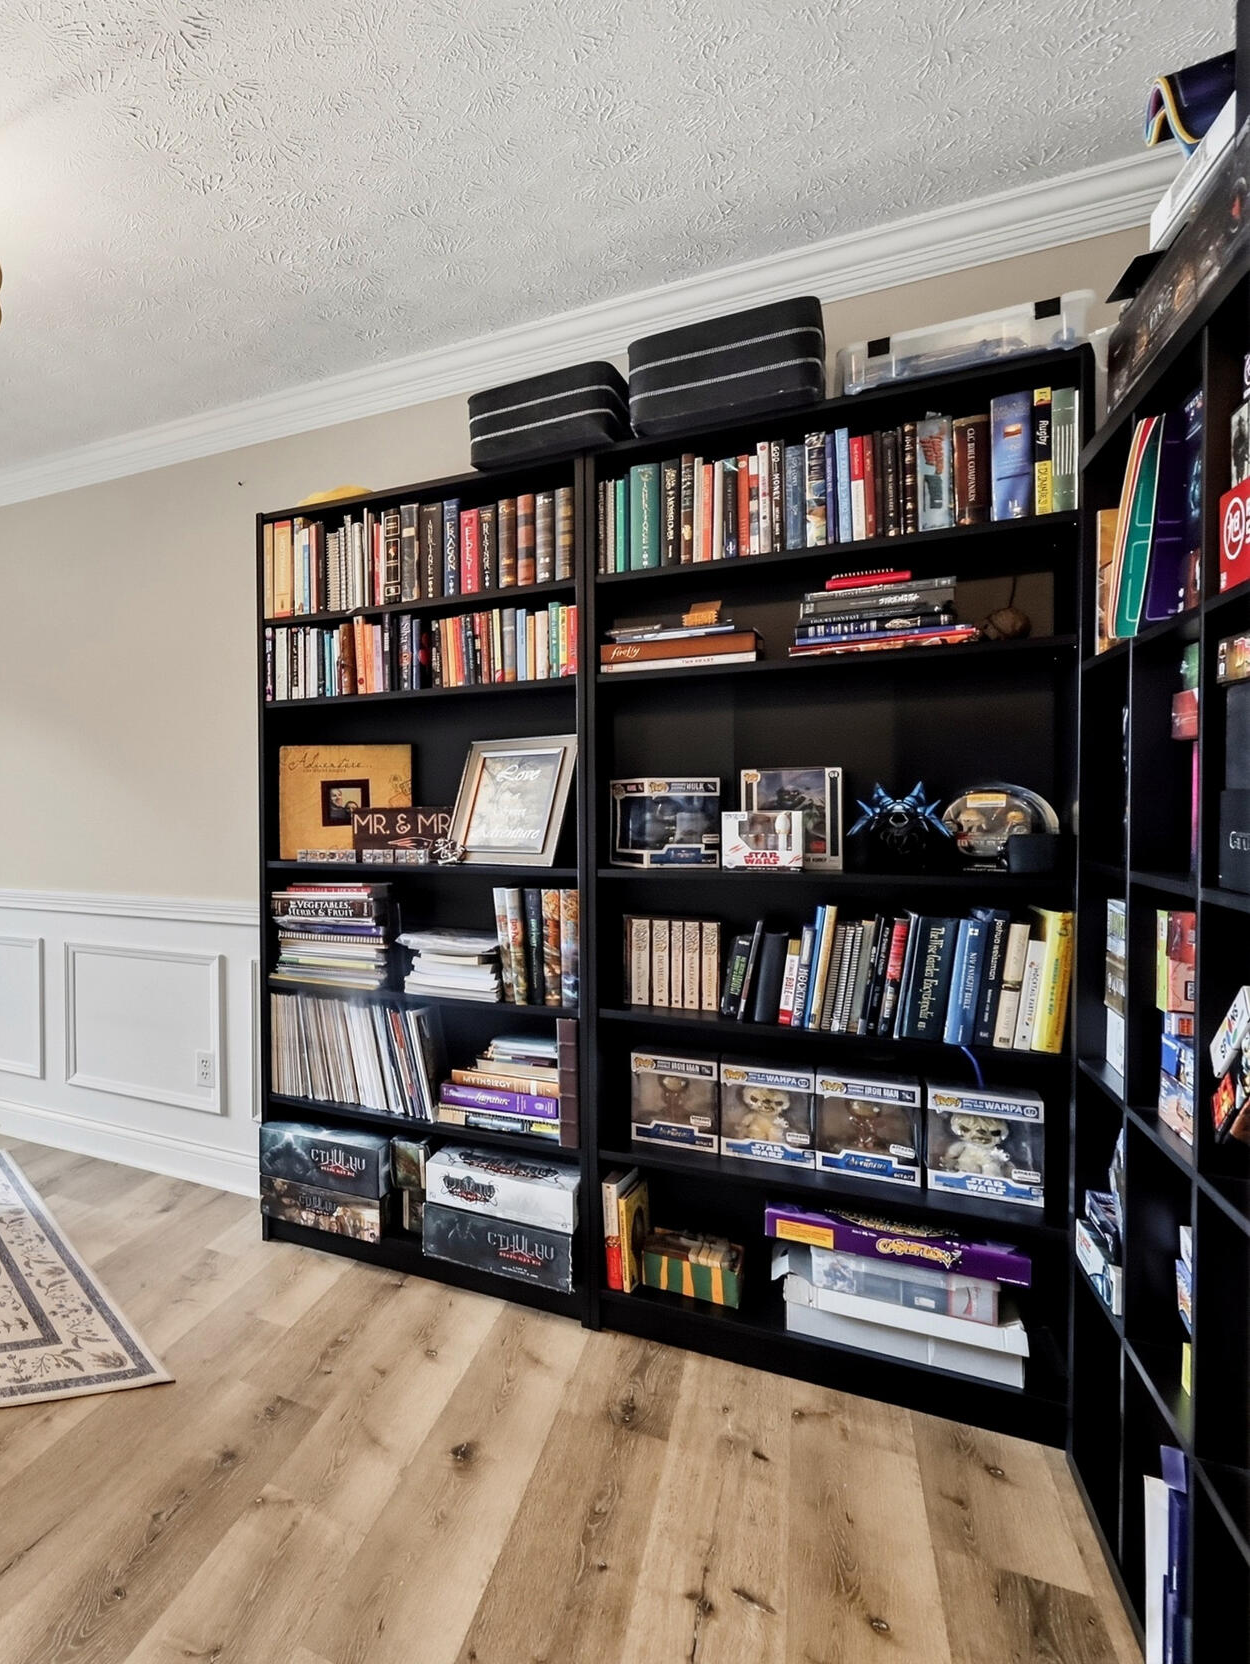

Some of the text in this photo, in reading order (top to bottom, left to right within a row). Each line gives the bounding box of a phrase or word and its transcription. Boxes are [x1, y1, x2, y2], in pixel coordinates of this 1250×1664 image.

[1036, 420, 1049, 446] Rugby
[495, 764, 542, 782] Love
[354, 813, 450, 835] MR. & MR
[744, 857, 780, 865] WARS
[318, 908, 326, 917] &
[328, 909, 354, 917] FRUIT
[930, 927, 945, 940] The
[993, 918, 1006, 944] joshua
[794, 968, 809, 1017] MOCKTAILS
[462, 1075, 512, 1089] MYTHOLOGY
[765, 1074, 797, 1085] WAMPA
[984, 1101, 1023, 1114] WAMPA
[751, 1143, 782, 1152] STAR
[751, 1149, 784, 1159] WARS
[311, 1148, 366, 1172] CTHULHU
[966, 1177, 1005, 1187] STAR
[966, 1184, 1007, 1195] WARS
[487, 1231, 554, 1260] CTHULHU
